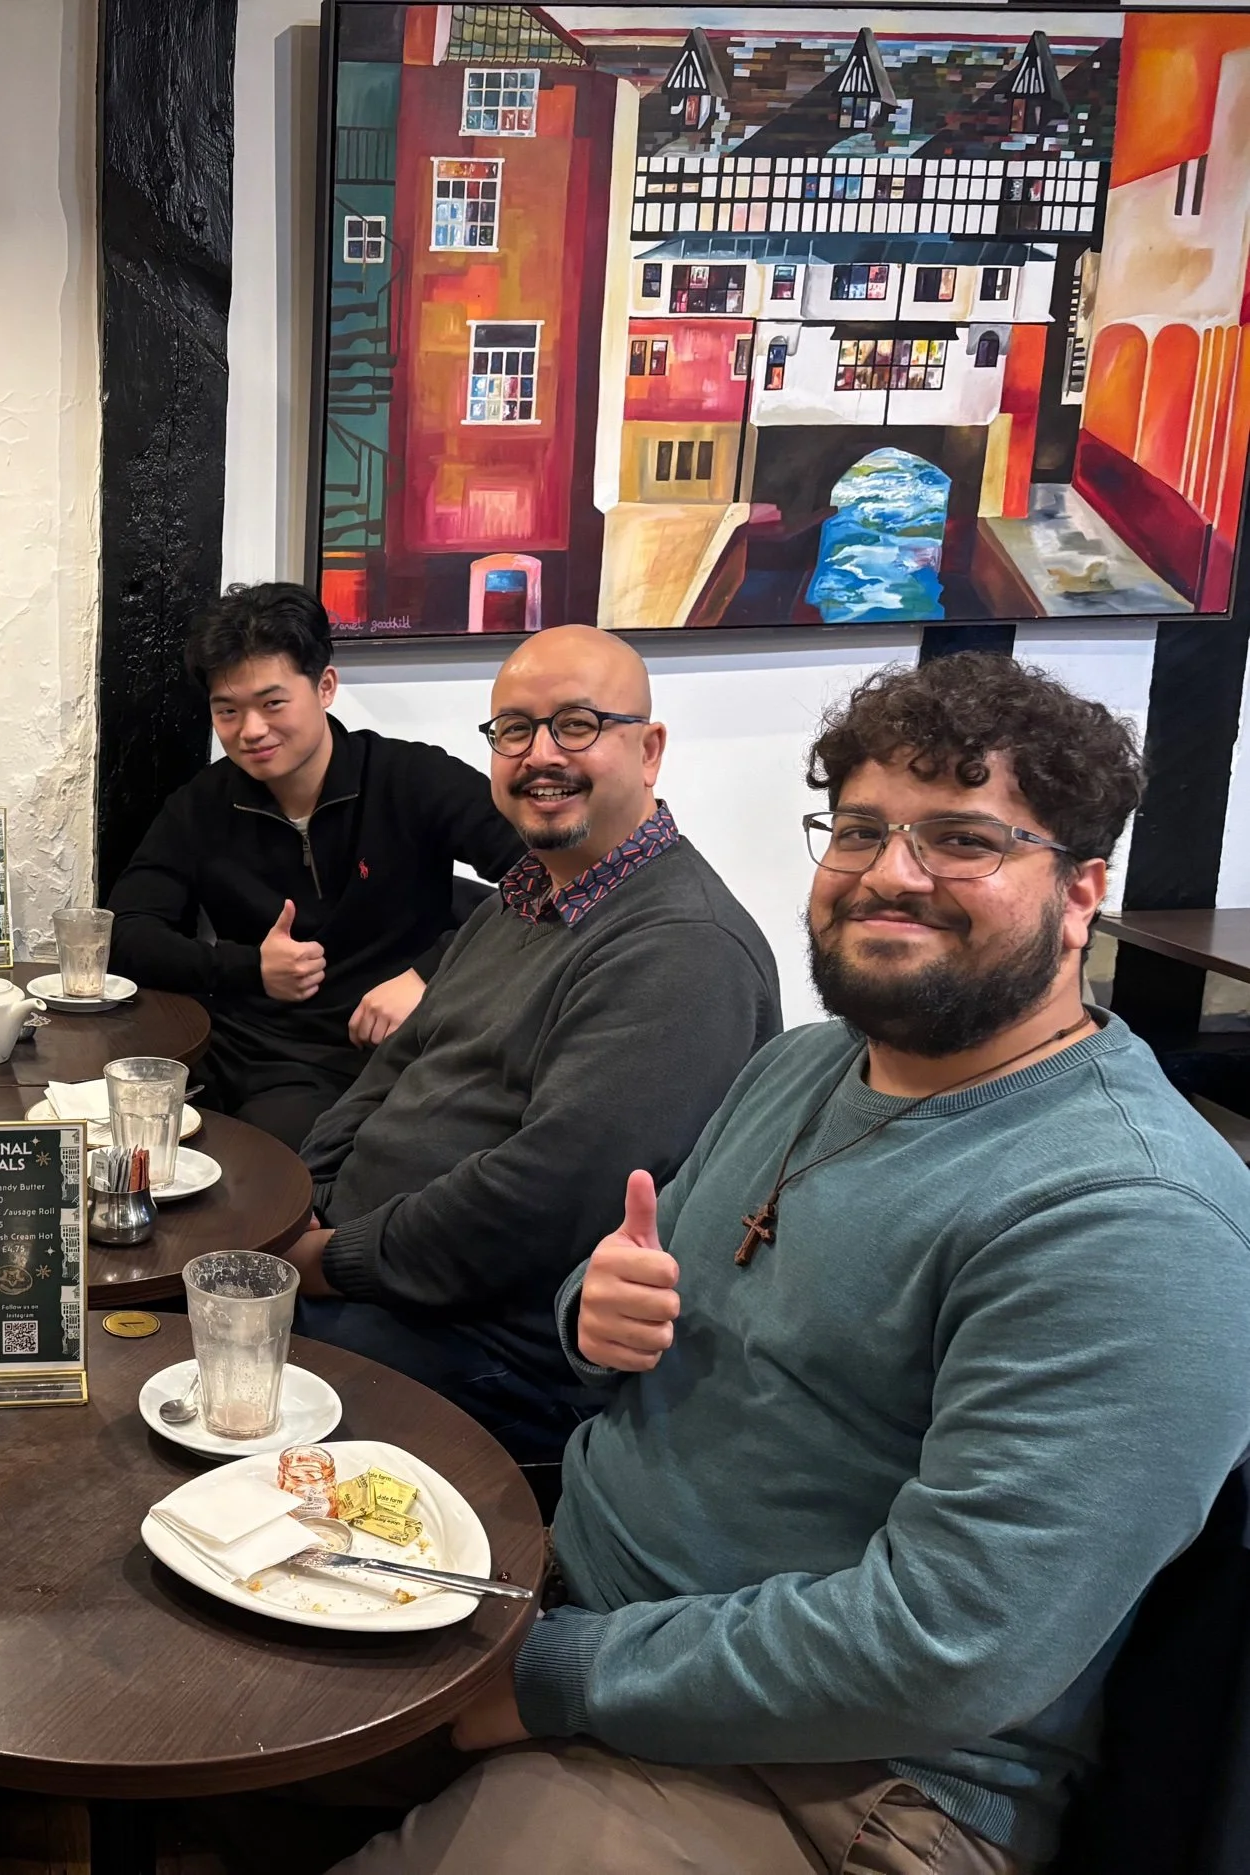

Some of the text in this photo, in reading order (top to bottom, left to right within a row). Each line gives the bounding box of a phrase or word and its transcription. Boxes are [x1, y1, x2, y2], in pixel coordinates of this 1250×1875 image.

[19, 1183, 46, 1191] Butter
[38, 1207, 55, 1215] Roll
[10, 1232, 36, 1241] Cream
[38, 1232, 54, 1240] Hot
[2, 1245, 25, 1253] £4.75
